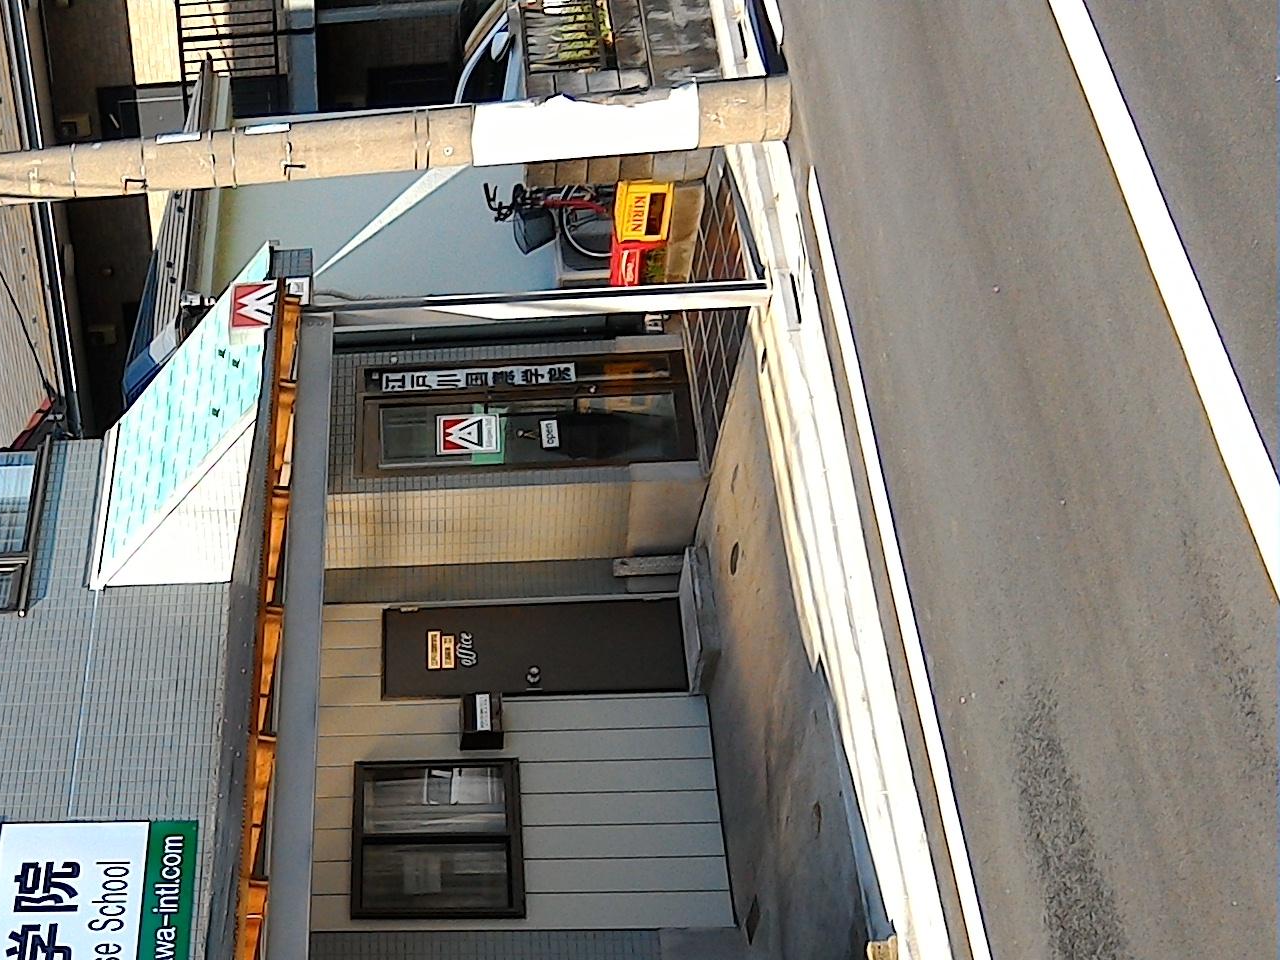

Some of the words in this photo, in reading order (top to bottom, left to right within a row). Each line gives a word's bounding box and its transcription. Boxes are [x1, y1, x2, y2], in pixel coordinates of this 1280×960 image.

[631, 195, 647, 232] KIRIN
[545, 422, 556, 445] open
[456, 632, 477, 666] office
[87, 861, 131, 931] School
